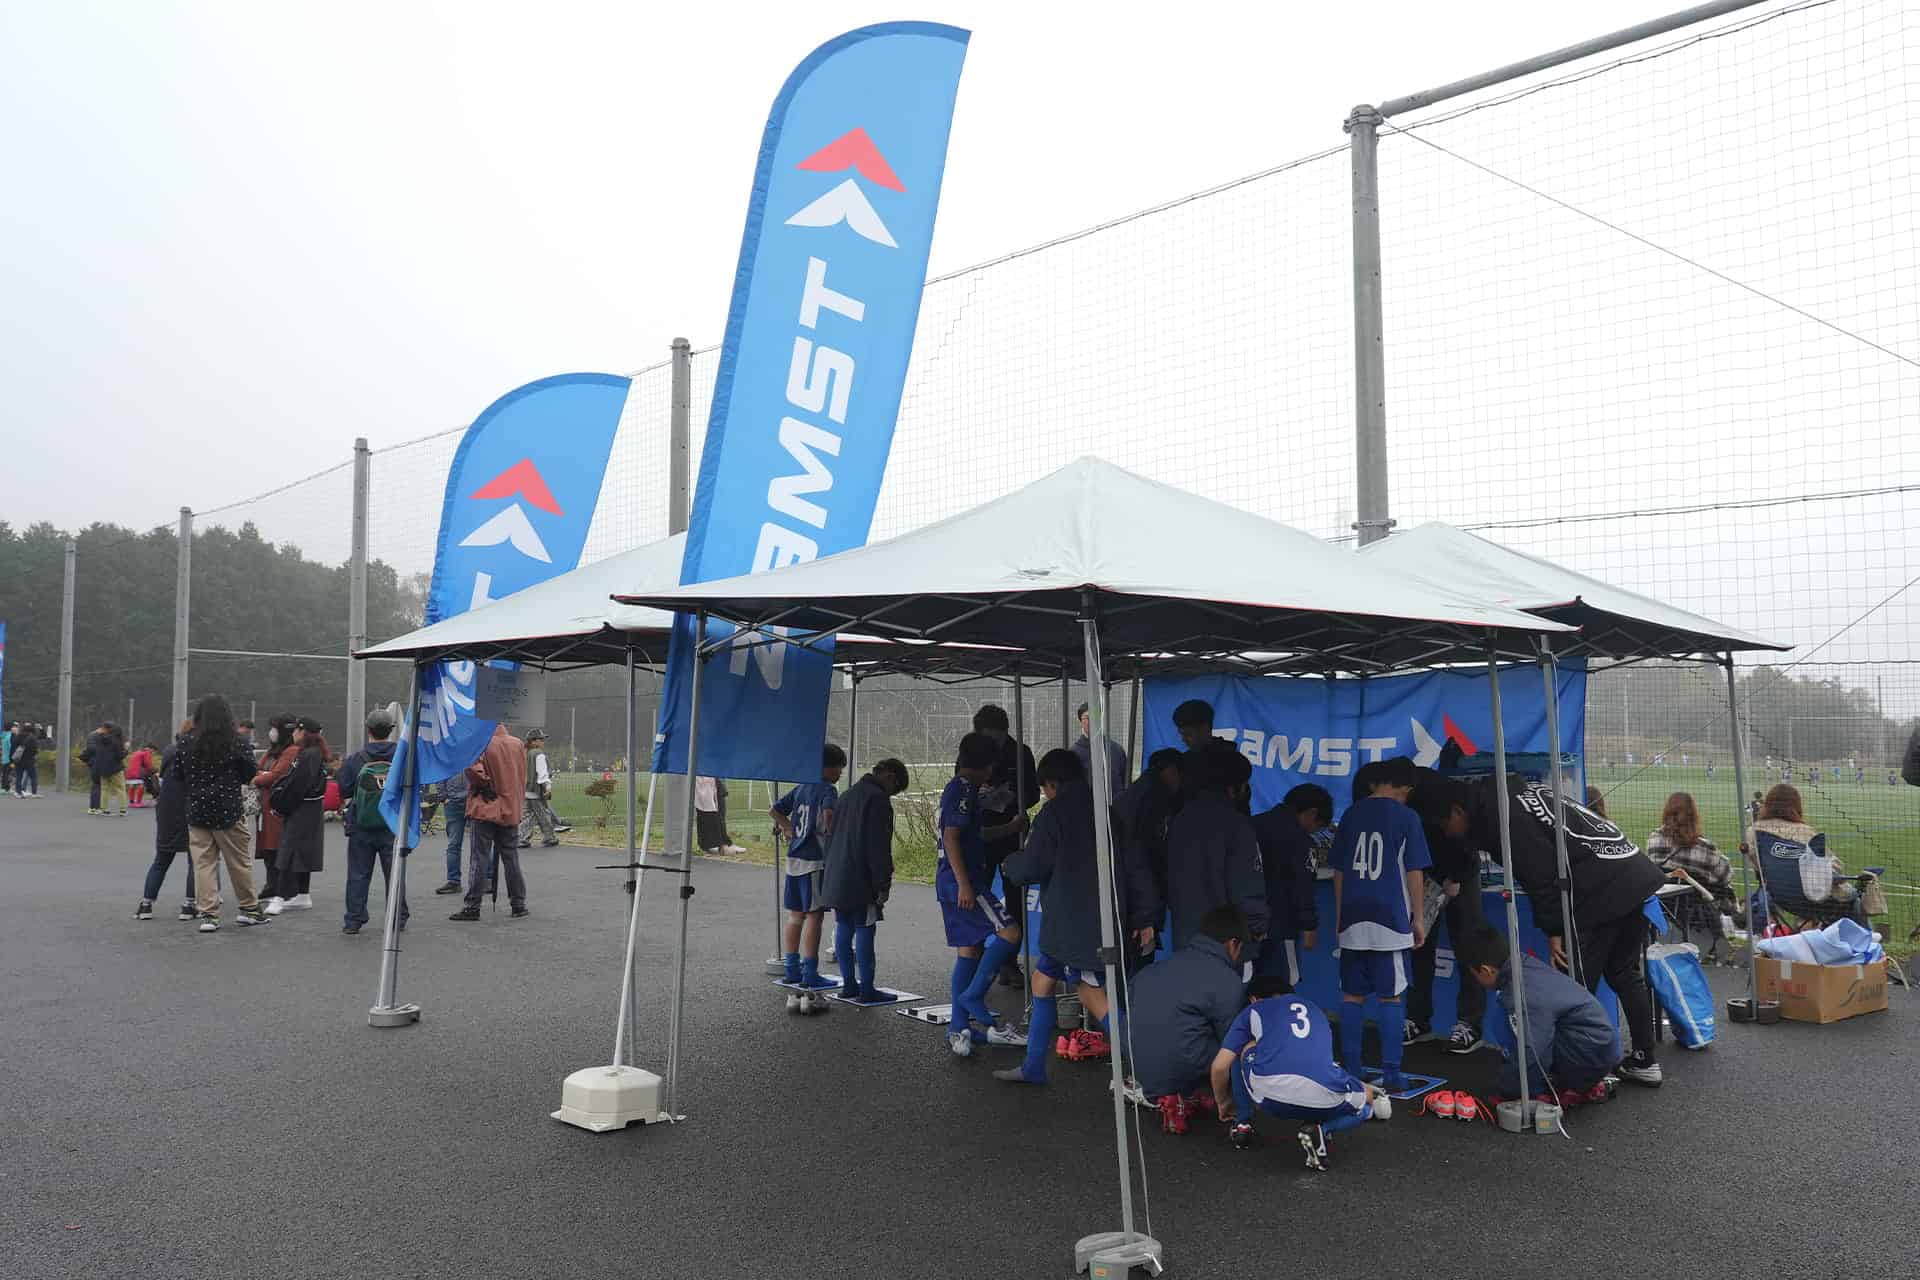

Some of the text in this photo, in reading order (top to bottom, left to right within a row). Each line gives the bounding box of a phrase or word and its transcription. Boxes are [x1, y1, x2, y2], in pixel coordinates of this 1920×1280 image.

[795, 804, 810, 839] 31
[1353, 831, 1384, 881] 40
[1290, 1003, 1311, 1039] 3
